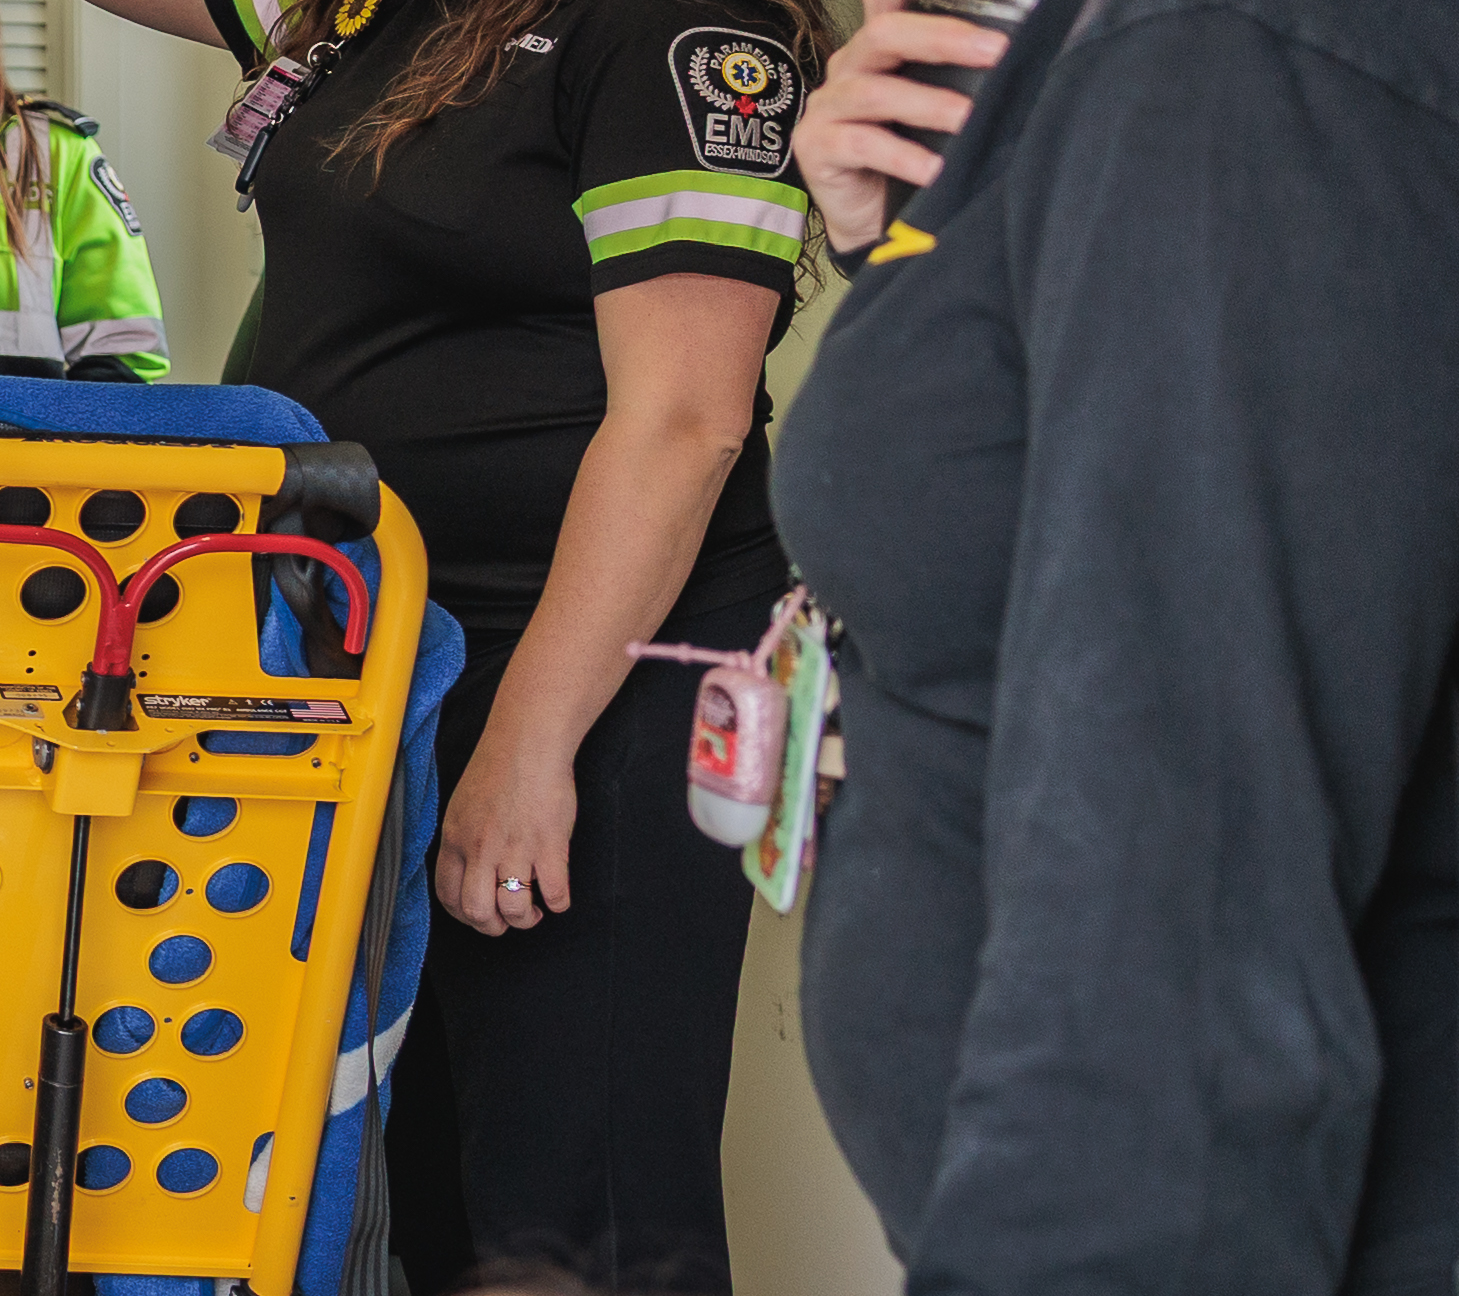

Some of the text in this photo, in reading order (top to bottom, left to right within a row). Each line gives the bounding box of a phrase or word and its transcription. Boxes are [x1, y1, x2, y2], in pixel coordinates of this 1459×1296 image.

[710, 42, 777, 80] PARAMEDIC
[705, 113, 783, 151] EMS
[705, 143, 780, 166] ESSEX-WINDSOR
[144, 695, 208, 707] stryker
